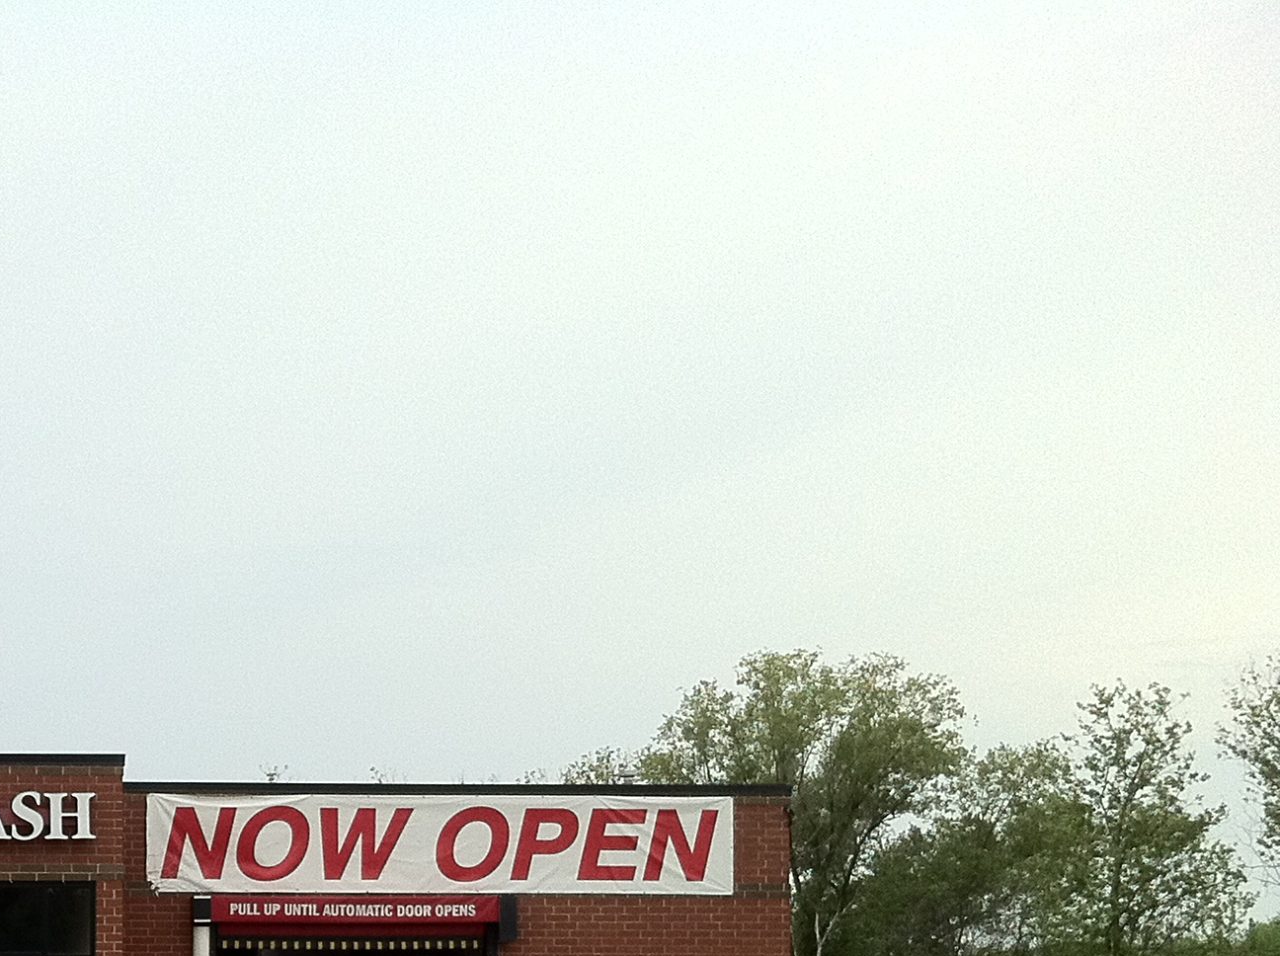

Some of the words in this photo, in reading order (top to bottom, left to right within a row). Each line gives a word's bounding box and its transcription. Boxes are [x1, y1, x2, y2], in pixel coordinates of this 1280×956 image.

[161, 806, 414, 882] NOW
[435, 806, 718, 883] OPEN
[229, 903, 260, 916] PULL
[263, 903, 282, 916] UP
[284, 903, 320, 917] UNTIL
[322, 904, 393, 917] AUTOMATIC
[396, 904, 432, 918] DOOR
[435, 904, 476, 917] OPENS
